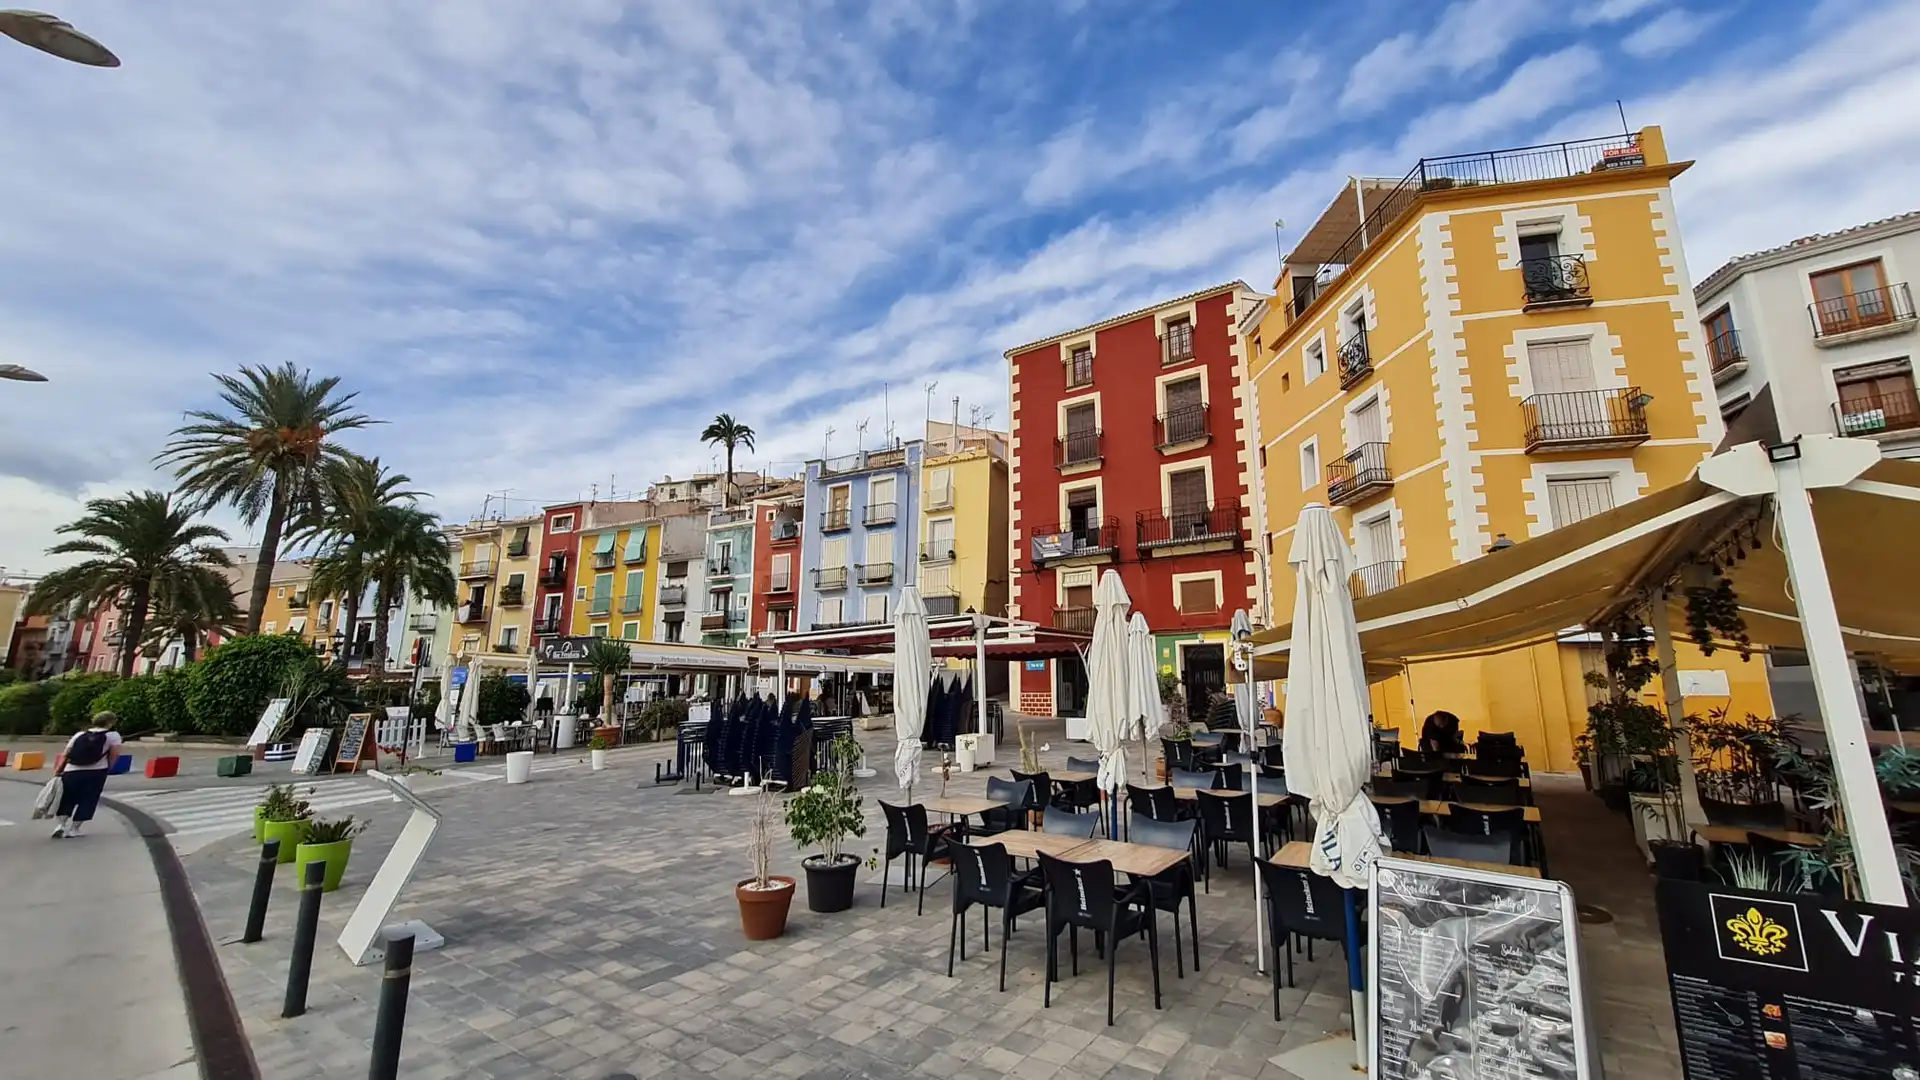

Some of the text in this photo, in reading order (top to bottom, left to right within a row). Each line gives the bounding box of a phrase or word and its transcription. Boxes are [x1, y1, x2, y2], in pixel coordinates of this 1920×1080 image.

[1621, 147, 1640, 155] RENT
[1076, 876, 1088, 911] Heineken
[1301, 879, 1315, 914] Heineken
[1419, 883, 1428, 896] del
[1820, 908, 1920, 966] VI
